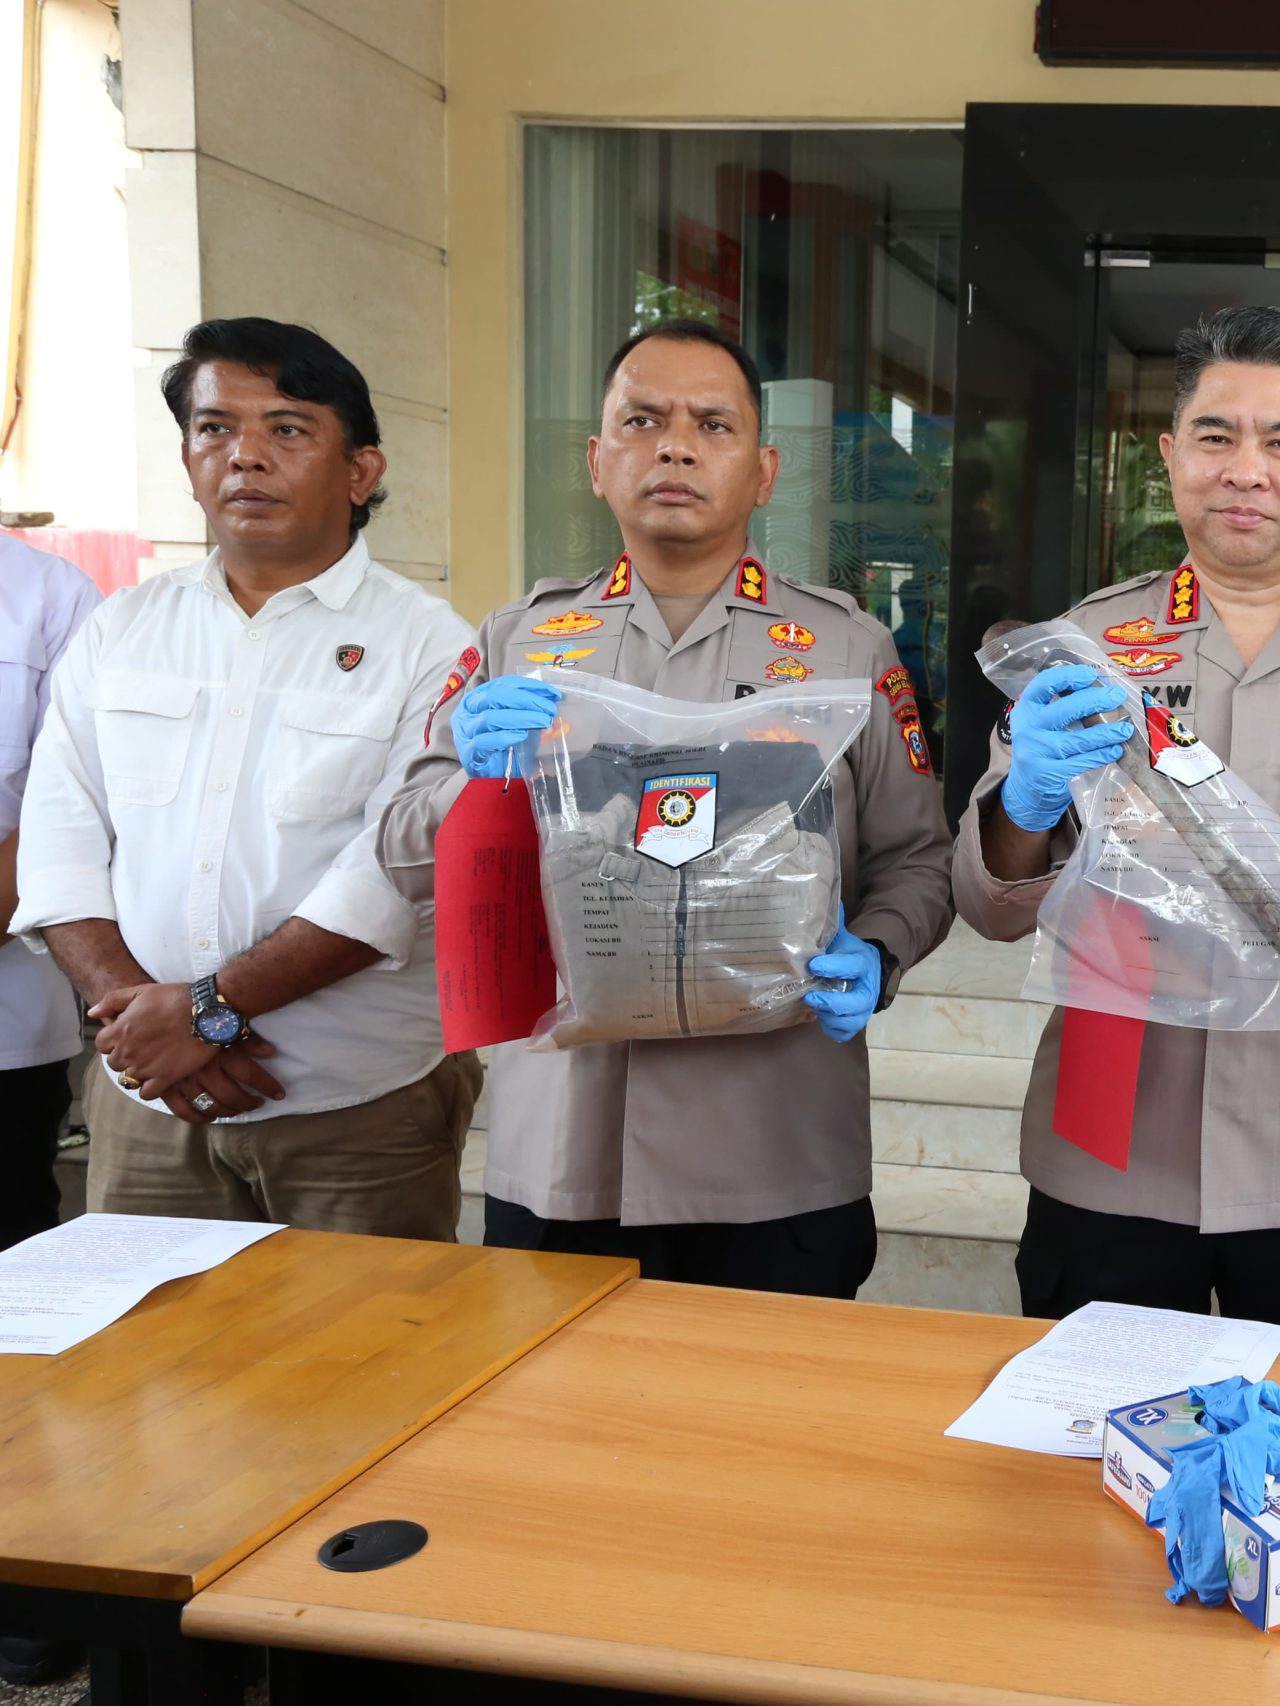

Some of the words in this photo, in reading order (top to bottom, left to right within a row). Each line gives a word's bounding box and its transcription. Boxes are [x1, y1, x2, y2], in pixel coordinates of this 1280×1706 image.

[649, 776, 710, 790] IDENTIFIKASI
[1136, 1408, 1163, 1425] XL
[1248, 1537, 1258, 1557] XL
